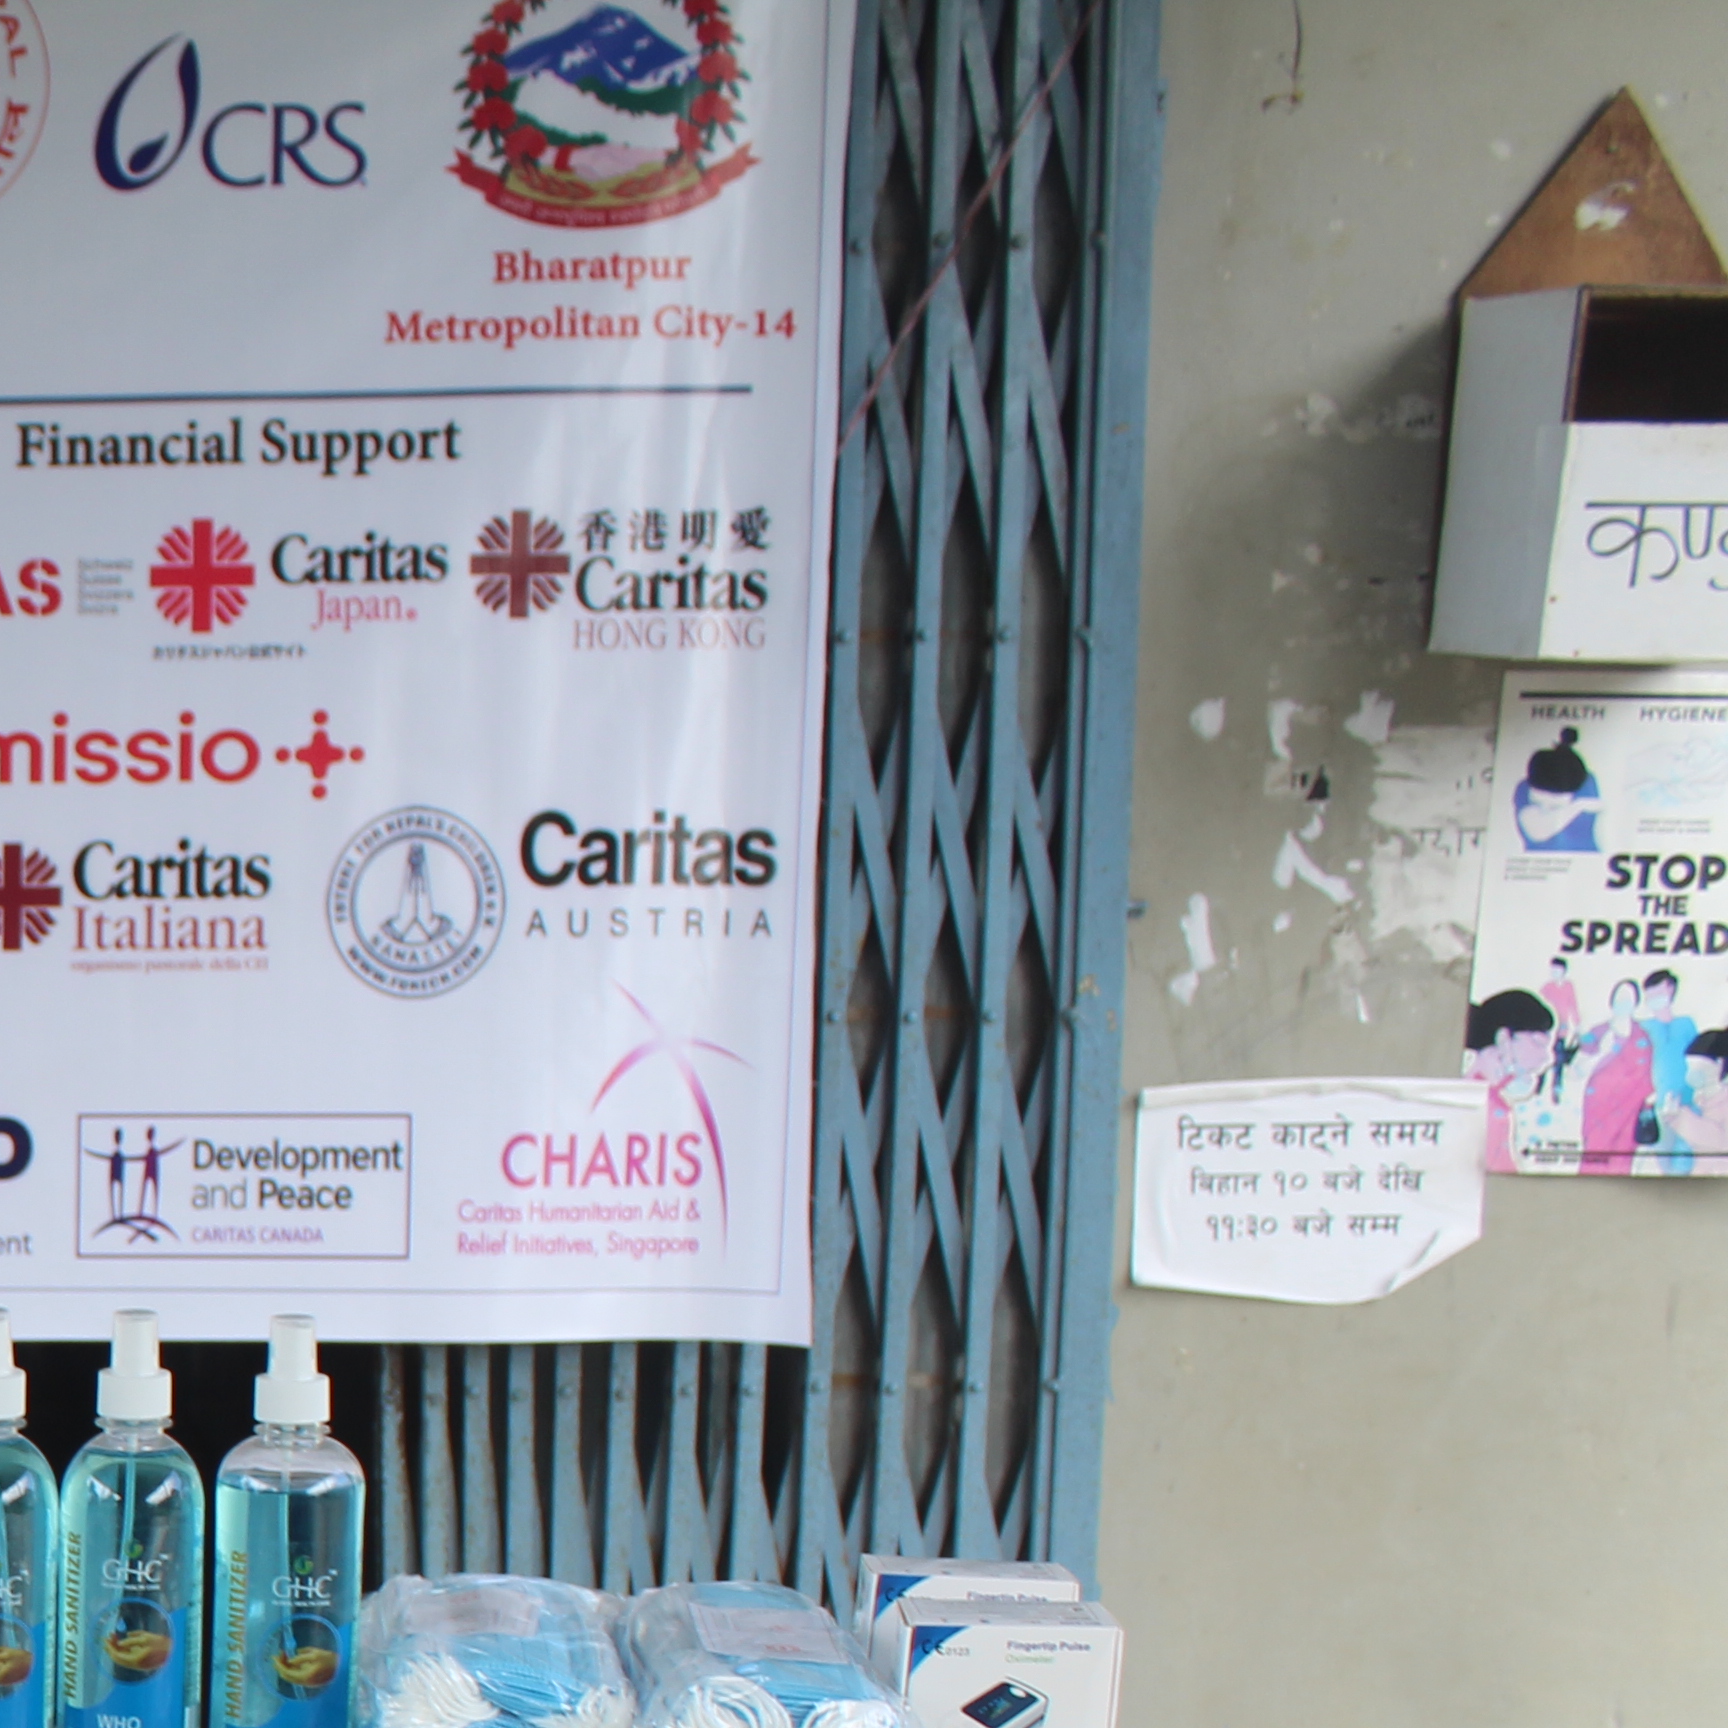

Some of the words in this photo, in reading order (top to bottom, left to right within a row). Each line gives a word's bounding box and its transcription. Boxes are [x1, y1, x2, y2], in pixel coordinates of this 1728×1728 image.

[199, 102, 370, 189] CRS
[493, 249, 692, 289] Bharatpur
[384, 306, 641, 351] Metropolitan
[651, 305, 797, 347] City-14
[15, 419, 244, 468] Financial
[258, 417, 461, 477] Support
[579, 506, 773, 553] 香港明愛
[271, 530, 448, 590] Caritas
[574, 553, 768, 613] Caritas
[572, 616, 666, 651] HONG
[677, 614, 767, 649] KONG
[1531, 705, 1606, 720] HEALTH
[1640, 706, 1728, 722] HYGIENE
[519, 809, 777, 888] Caritas
[73, 837, 271, 902] Caritas
[1606, 854, 1728, 890] STOP
[526, 905, 773, 942] AUSTRIA
[1638, 894, 1688, 916] THE
[70, 902, 269, 952] Italiana
[1560, 920, 1728, 954] SPREAD
[1177, 1114, 1256, 1150] टिकट
[1272, 1113, 1353, 1155] काट्ने
[1369, 1120, 1443, 1146] समय
[191, 1137, 402, 1178] Development
[501, 1132, 702, 1188] CHARIS
[191, 1179, 248, 1211] and
[257, 1179, 353, 1213] Peace
[1190, 1164, 1261, 1194] बिहान
[1273, 1170, 1307, 1195] १०
[1323, 1164, 1364, 1191] बजे
[1377, 1162, 1425, 1192] देखि
[457, 1200, 522, 1223] Caritas
[529, 1201, 642, 1222] Humanitarian
[649, 1200, 679, 1221] Aid
[1207, 1214, 1278, 1240] ११:३०
[1293, 1208, 1333, 1235] बजे
[1348, 1214, 1402, 1235] सम्म
[191, 1225, 256, 1242] CARITAS
[261, 1225, 324, 1242] CANADA
[457, 1231, 507, 1255] Relief
[514, 1232, 598, 1256] Initiatives,
[607, 1230, 699, 1260] Singapore
